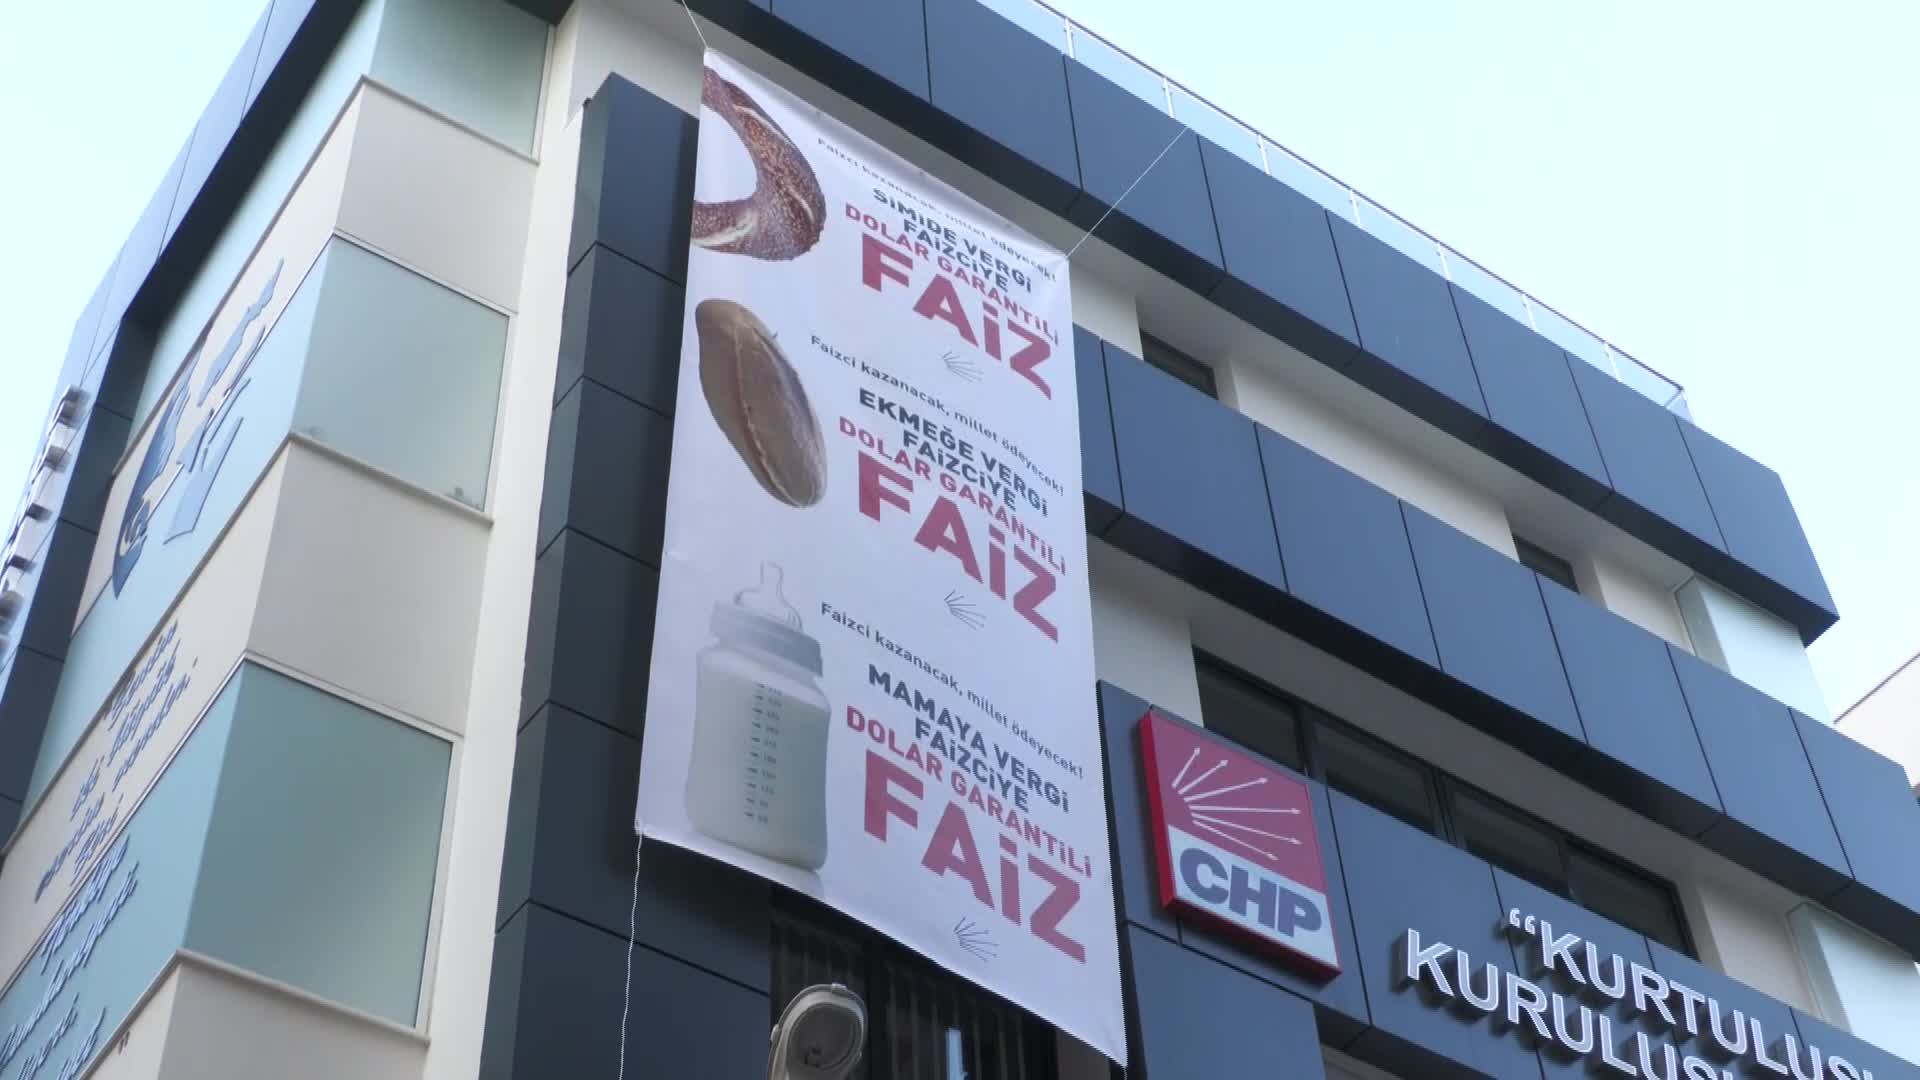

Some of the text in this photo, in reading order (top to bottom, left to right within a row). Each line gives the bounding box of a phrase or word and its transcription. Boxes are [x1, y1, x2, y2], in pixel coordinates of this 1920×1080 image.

[845, 202, 930, 261] DOLAR
[811, 335, 1064, 497] Faizci kazanacak, millet ödeyecek!
[839, 415, 931, 480] DOLAR
[859, 387, 975, 462] EKMEĞE
[821, 601, 1084, 780] Faizci kazanacak, millet ödeyecek!
[869, 664, 988, 758] MAMAYA
[847, 705, 943, 782] DOLAR
[1180, 848, 1322, 938] CHP
